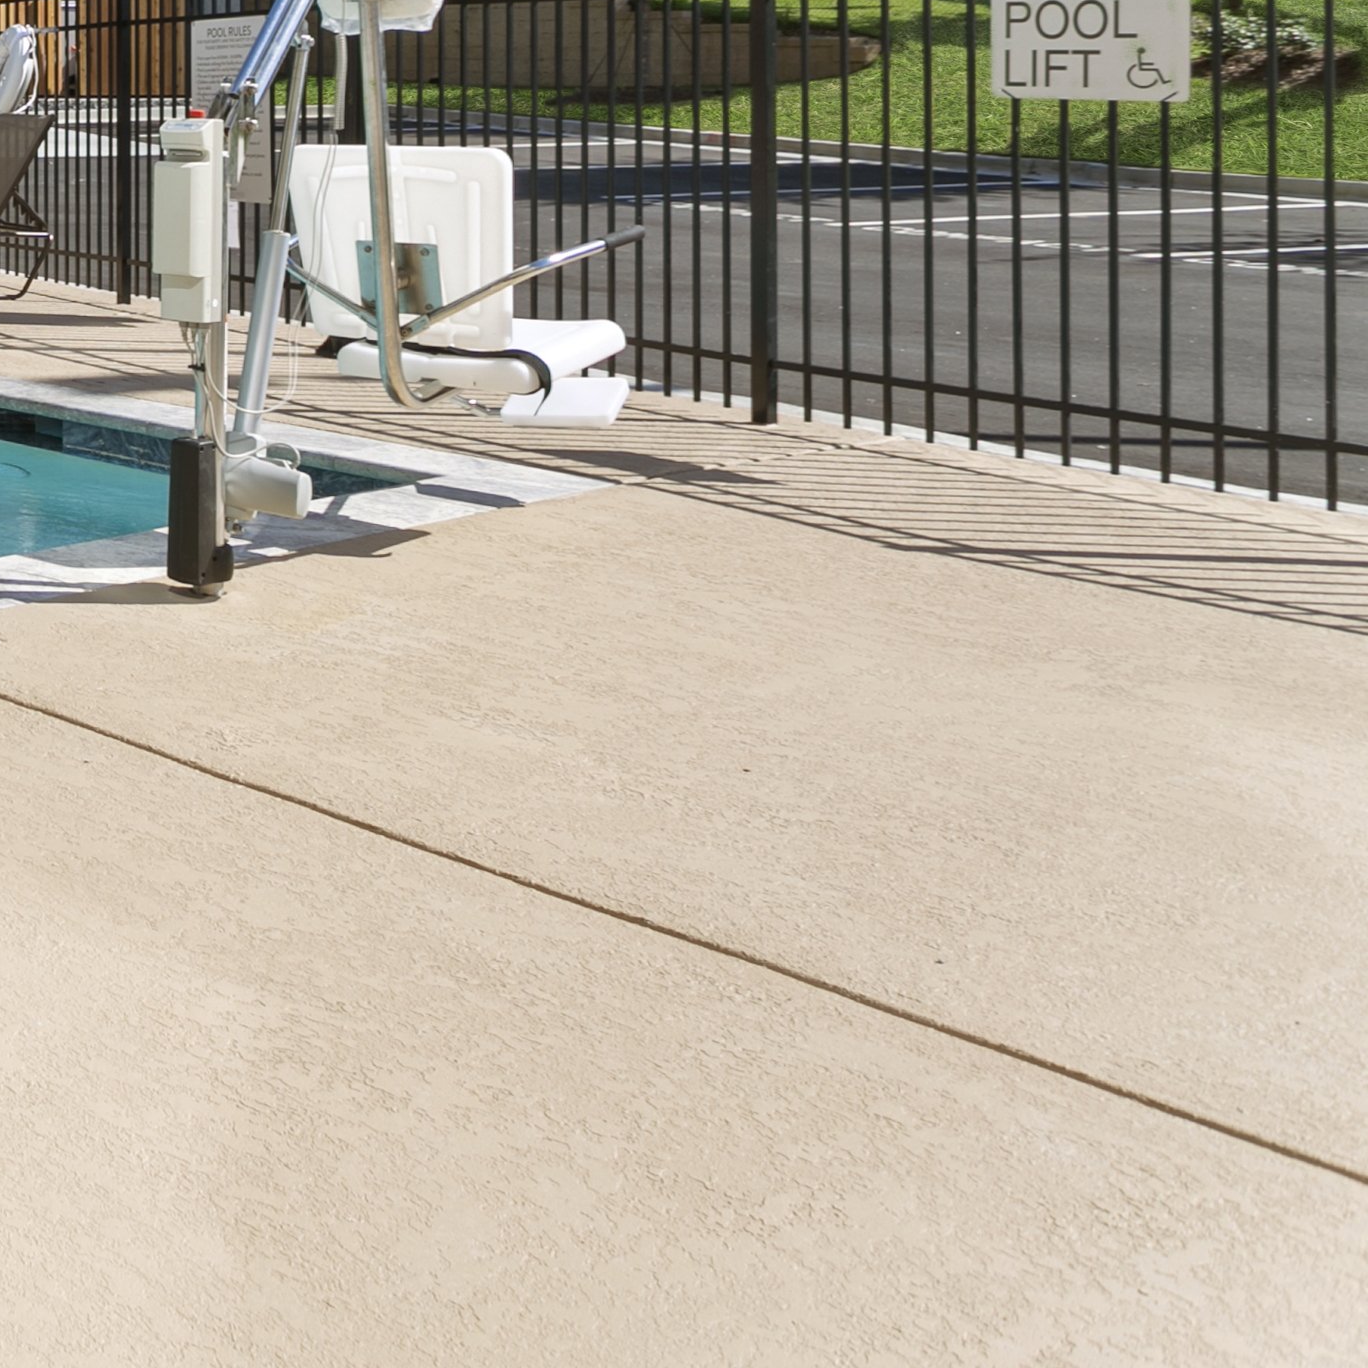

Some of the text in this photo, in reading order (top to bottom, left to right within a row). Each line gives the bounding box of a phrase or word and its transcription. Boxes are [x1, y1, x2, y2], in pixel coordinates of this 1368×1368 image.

[207, 25, 252, 38] POOL RULES
[1005, 0, 1138, 40] POOL
[1004, 49, 1101, 88] LIFT
